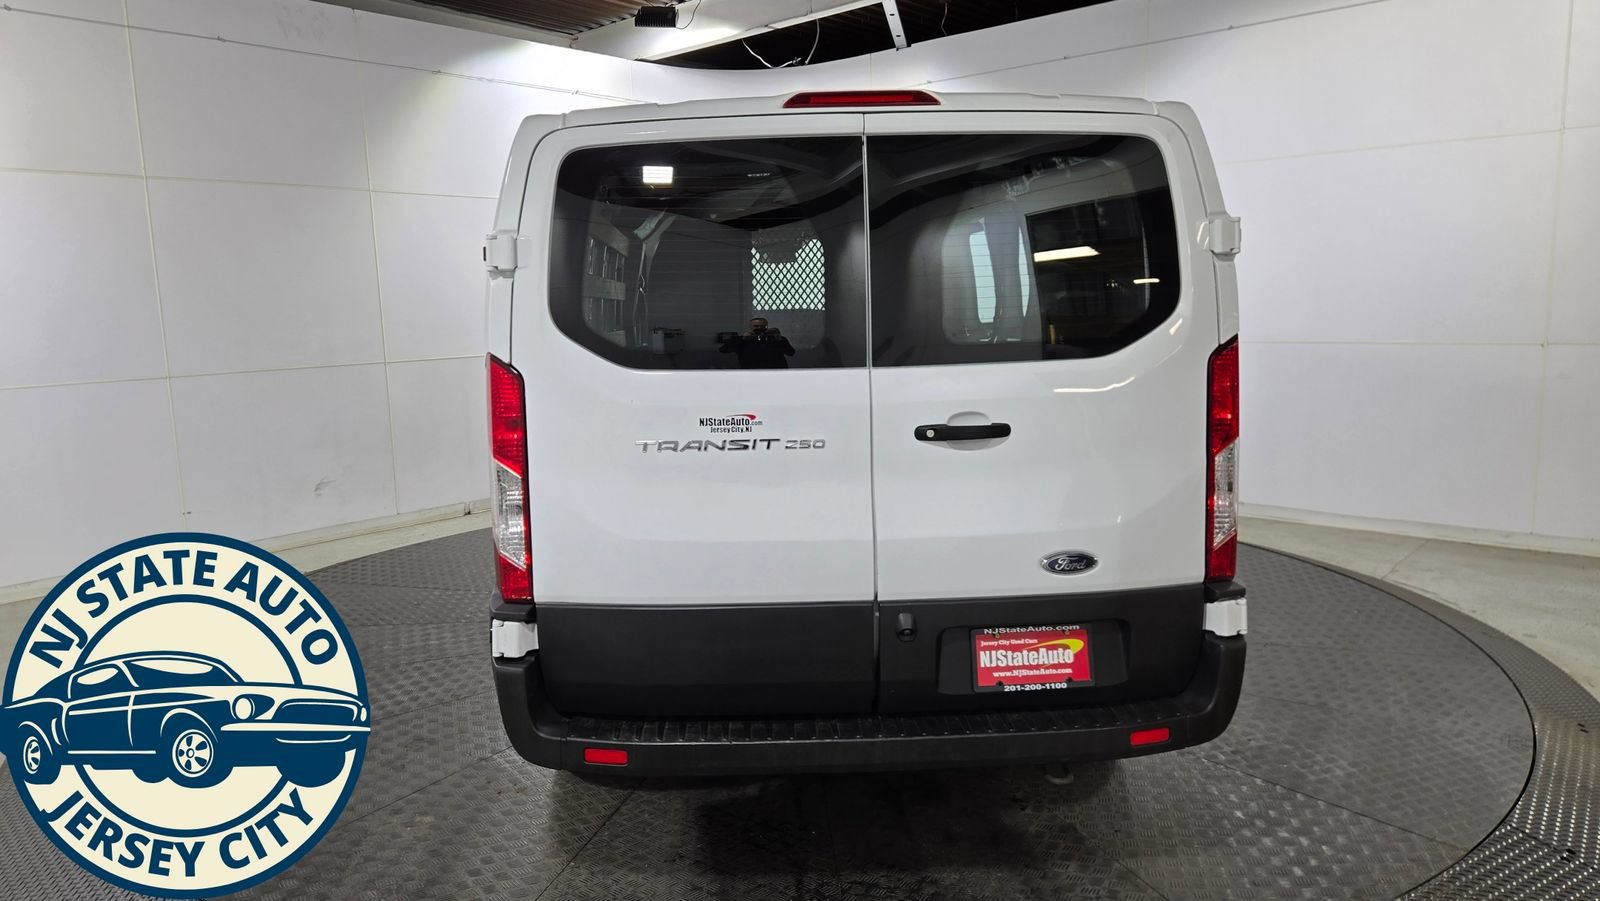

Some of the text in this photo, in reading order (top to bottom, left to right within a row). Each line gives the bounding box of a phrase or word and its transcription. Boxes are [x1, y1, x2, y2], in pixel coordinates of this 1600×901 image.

[699, 417, 763, 426] NJStateAuto.com
[634, 438, 826, 453] TRANSIT 250
[1055, 556, 1087, 571] Ford
[983, 624, 1080, 635] NJStateAuto.com
[979, 647, 1074, 668] NJStateAuto
[992, 667, 1072, 678] www.NJStateAuto.com
[1004, 682, 1067, 692] 201-200-1100
